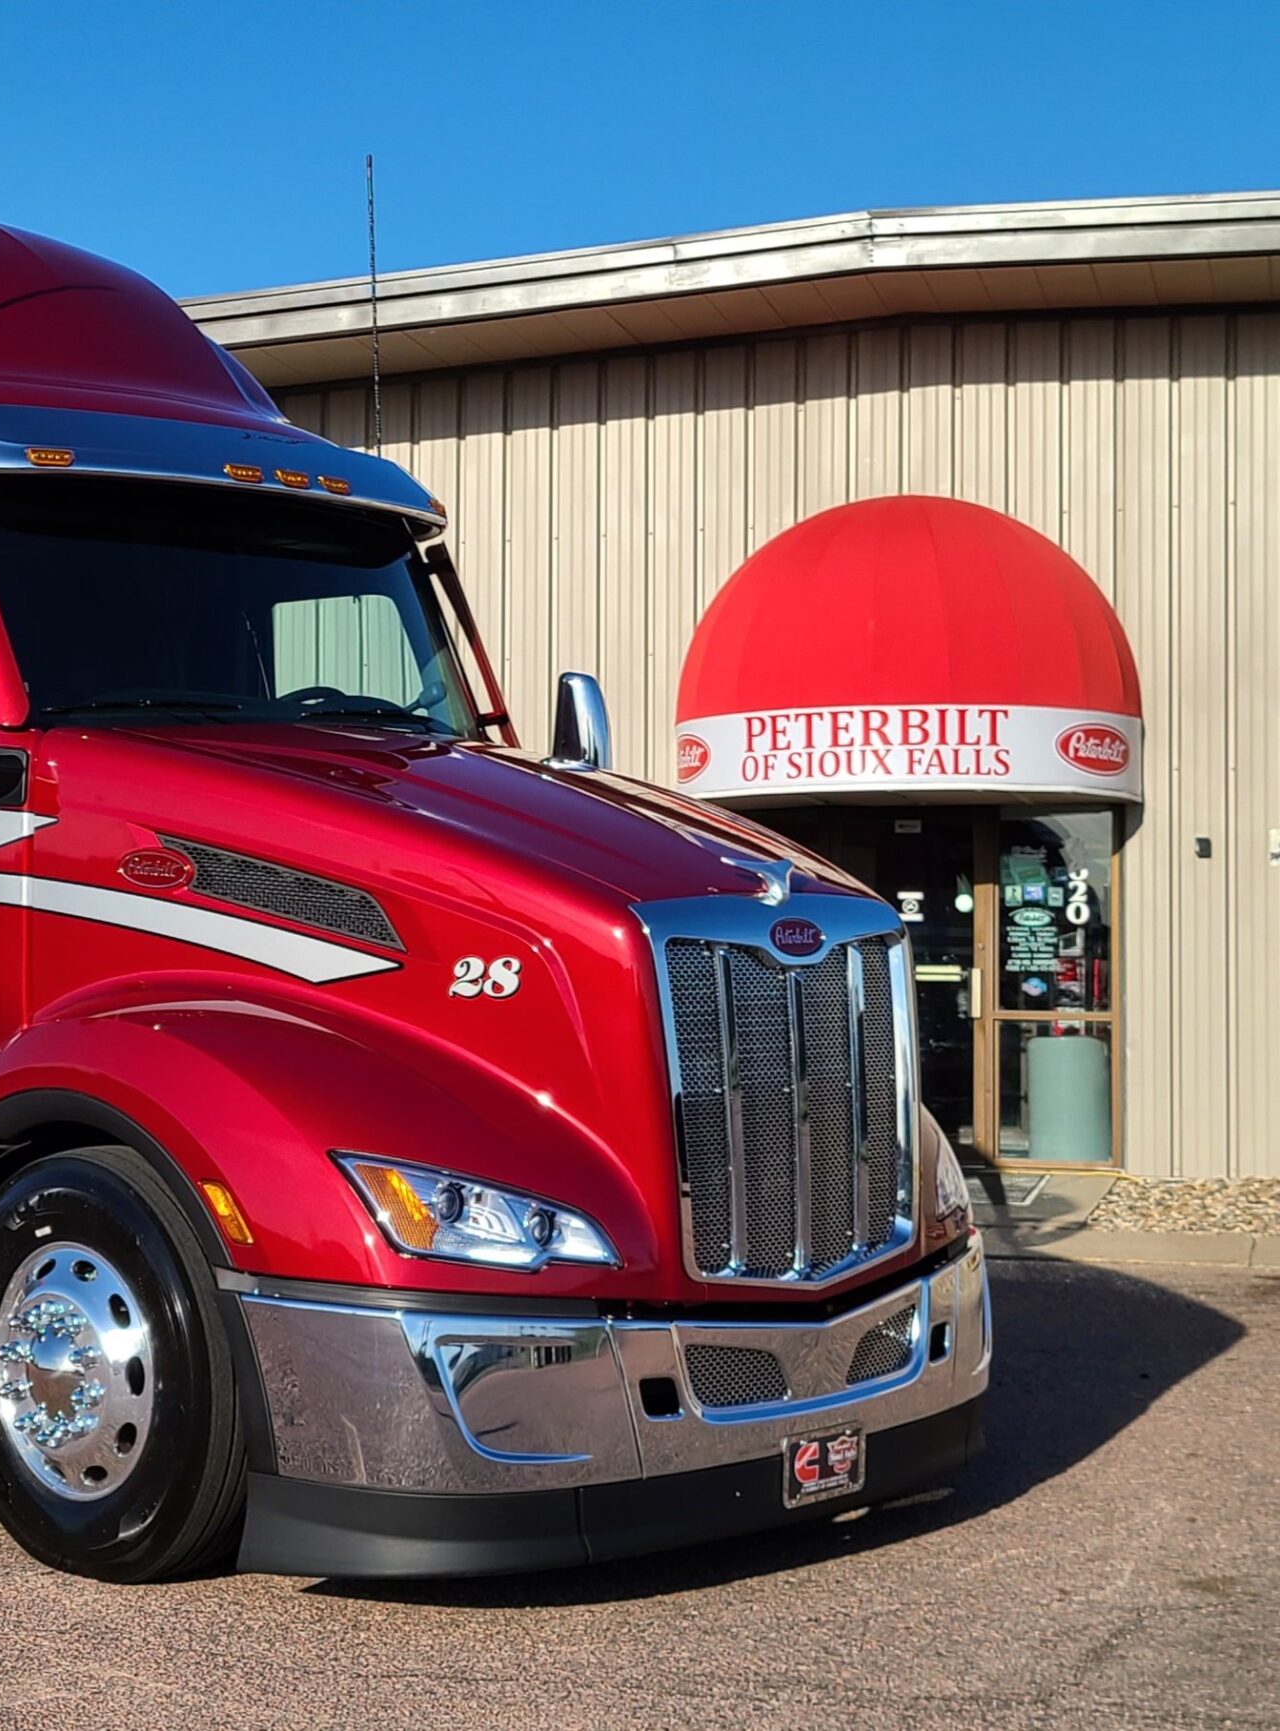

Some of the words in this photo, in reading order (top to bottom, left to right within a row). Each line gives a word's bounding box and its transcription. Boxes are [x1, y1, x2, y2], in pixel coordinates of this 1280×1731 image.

[744, 709, 1009, 753] PETERBILT
[1068, 731, 1126, 764] Peterbilt
[742, 753, 777, 782] OF
[786, 748, 894, 779] SIOUX
[906, 748, 1011, 777] FALLS
[448, 955, 522, 999] 28
